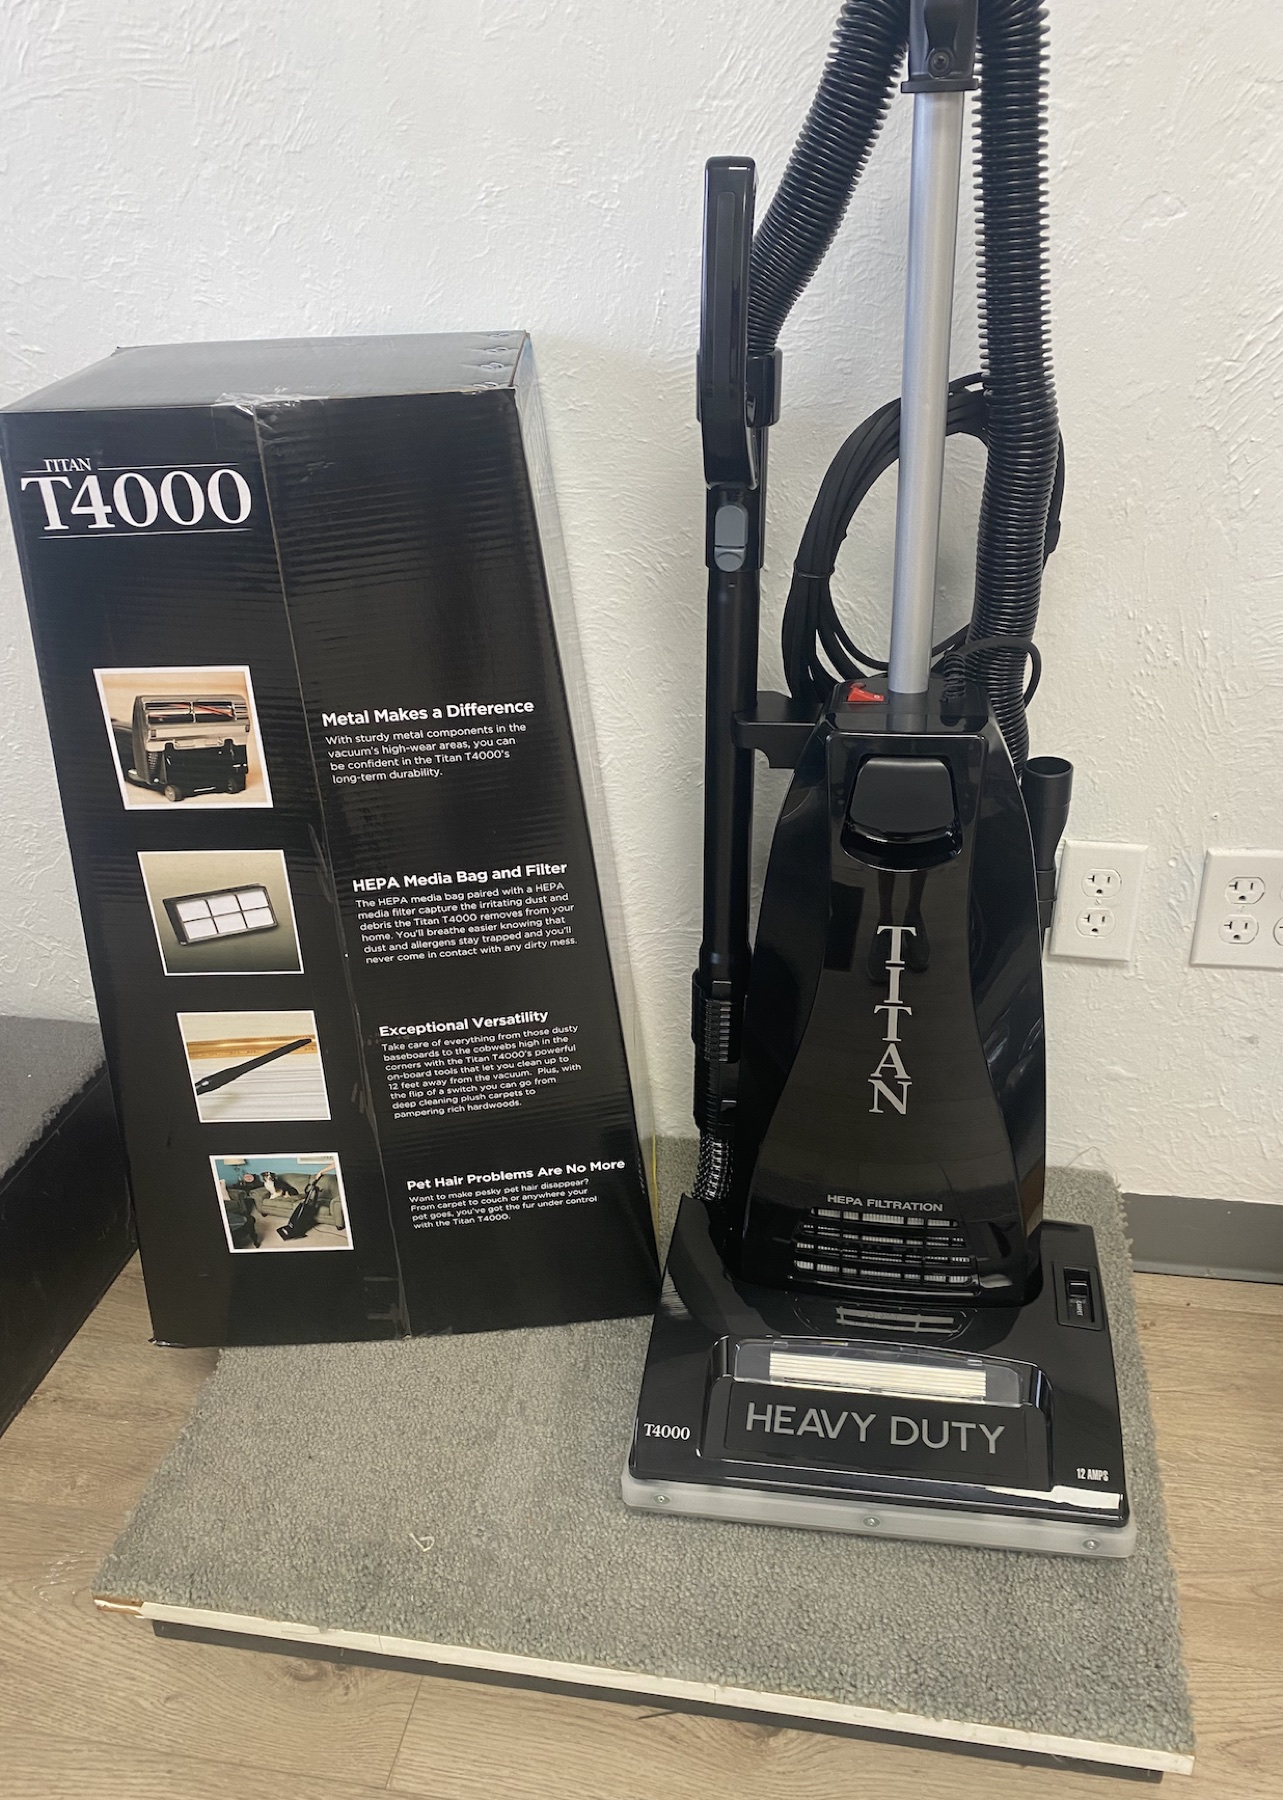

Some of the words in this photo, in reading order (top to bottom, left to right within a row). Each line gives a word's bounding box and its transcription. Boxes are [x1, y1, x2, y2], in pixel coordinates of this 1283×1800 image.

[44, 458, 91, 472] TITAN
[21, 468, 252, 531] T4000
[322, 710, 370, 727] Metal
[374, 708, 428, 723] Makes
[432, 708, 442, 719] a
[446, 702, 535, 718] Difference
[325, 735, 353, 745] With
[355, 732, 390, 743] sturdy
[393, 730, 424, 740] metal
[427, 726, 494, 738] components
[496, 724, 506, 733] in
[509, 723, 526, 732] the
[328, 746, 380, 758] vacuum's
[382, 743, 436, 755] high-wear
[439, 741, 471, 750] areas,
[473, 739, 494, 749] you
[496, 738, 516, 746] can
[330, 762, 345, 771] be
[348, 758, 400, 770] confident
[402, 757, 412, 766] in
[414, 756, 432, 765] the
[434, 754, 462, 763] Titan
[464, 750, 510, 761] T4000's
[332, 773, 386, 784] long-term
[389, 768, 443, 780] durability.
[353, 876, 401, 892] HEPA
[404, 872, 453, 888] Media
[456, 871, 488, 883] Bag
[492, 865, 522, 880] and
[526, 863, 567, 877] Filter
[355, 900, 376, 908] The
[378, 897, 408, 906] HEPA
[411, 894, 442, 903] media
[444, 893, 464, 901] bag
[467, 888, 499, 900] paired
[502, 886, 524, 895] with
[536, 882, 565, 892] HEPA
[358, 909, 390, 920] media
[392, 908, 416, 917] filter
[418, 905, 458, 915] capture
[460, 902, 477, 911] the
[479, 899, 522, 909] irritating
[525, 896, 547, 904] dust
[550, 893, 569, 902] and
[360, 921, 392, 931] debris
[394, 920, 411, 928] the
[413, 918, 440, 926] Titan
[442, 913, 478, 924] T4000
[480, 910, 523, 921] removes
[525, 908, 549, 916] from
[552, 905, 574, 915] your
[362, 933, 394, 942] home.
[396, 929, 424, 939] You'll
[427, 926, 466, 936] breathe
[468, 924, 498, 933] easier
[500, 920, 543, 930] knowing
[545, 916, 566, 925] that
[364, 944, 386, 953] dust
[389, 942, 408, 951] and
[411, 939, 456, 949] allergens
[459, 937, 479, 945] stay
[482, 931, 522, 943] trapped
[524, 929, 543, 939] and
[545, 926, 572, 938] you'll
[366, 956, 394, 964] never
[397, 953, 425, 961] come
[439, 948, 478, 958] contact
[480, 945, 502, 954] with
[504, 944, 522, 952] any
[524, 941, 548, 950] dirty
[550, 938, 577, 947] mess.
[379, 1018, 469, 1037] Exceptional
[472, 1011, 548, 1029] Versatility
[867, 926, 917, 1115] TITAN
[381, 1043, 406, 1051] Take
[432, 1039, 441, 1047] of
[444, 1035, 496, 1046] everything
[523, 1029, 550, 1037] those
[552, 1025, 578, 1034] dusty
[383, 1050, 440, 1061] baseboards
[455, 1047, 471, 1055] the
[473, 1042, 516, 1053] cobwebs
[519, 1039, 540, 1048] high
[553, 1036, 569, 1044] the
[385, 1062, 422, 1071] corners
[424, 1059, 445, 1067] with
[492, 1050, 532, 1061] T4000's
[535, 1044, 576, 1057] powerful
[387, 1070, 432, 1081] on-board
[434, 1068, 458, 1076] tools
[460, 1066, 480, 1074] that
[496, 1063, 515, 1071] you
[517, 1060, 542, 1068] clean
[392, 1101, 416, 1109] deep
[419, 1097, 458, 1107] cleaning
[461, 1094, 486, 1103] plush
[488, 1090, 523, 1100] carpets
[409, 1090, 424, 1098] flip
[427, 1088, 436, 1096] of
[447, 1085, 478, 1094] switch
[480, 1084, 498, 1092] you
[519, 1080, 532, 1088] go
[535, 1077, 556, 1085] from
[407, 1179, 432, 1191] Pet
[435, 1176, 464, 1188] Hair
[467, 1170, 534, 1184] Problems
[537, 1167, 563, 1177] Are
[566, 1164, 587, 1174] No
[590, 1160, 625, 1172] More
[409, 1195, 434, 1203] Want
[448, 1191, 473, 1199] make
[475, 1188, 502, 1197] pesky
[504, 1186, 519, 1194] pet
[541, 1178, 589, 1190] disappear?
[411, 1204, 435, 1212] From
[437, 1200, 466, 1209] carpet
[481, 1196, 508, 1204] couch
[522, 1191, 566, 1200] anywhere
[568, 1189, 588, 1197] your
[827, 1194, 863, 1207] HEPA
[866, 1199, 943, 1212] FILTRATION
[477, 1213, 511, 1222] T4000.
[644, 1423, 691, 1441] T4000
[745, 1402, 877, 1443] HEAVY
[890, 1416, 1005, 1454] DUTY
[1076, 1468, 1086, 1480] 12
[1087, 1468, 1110, 1482] AMPS
